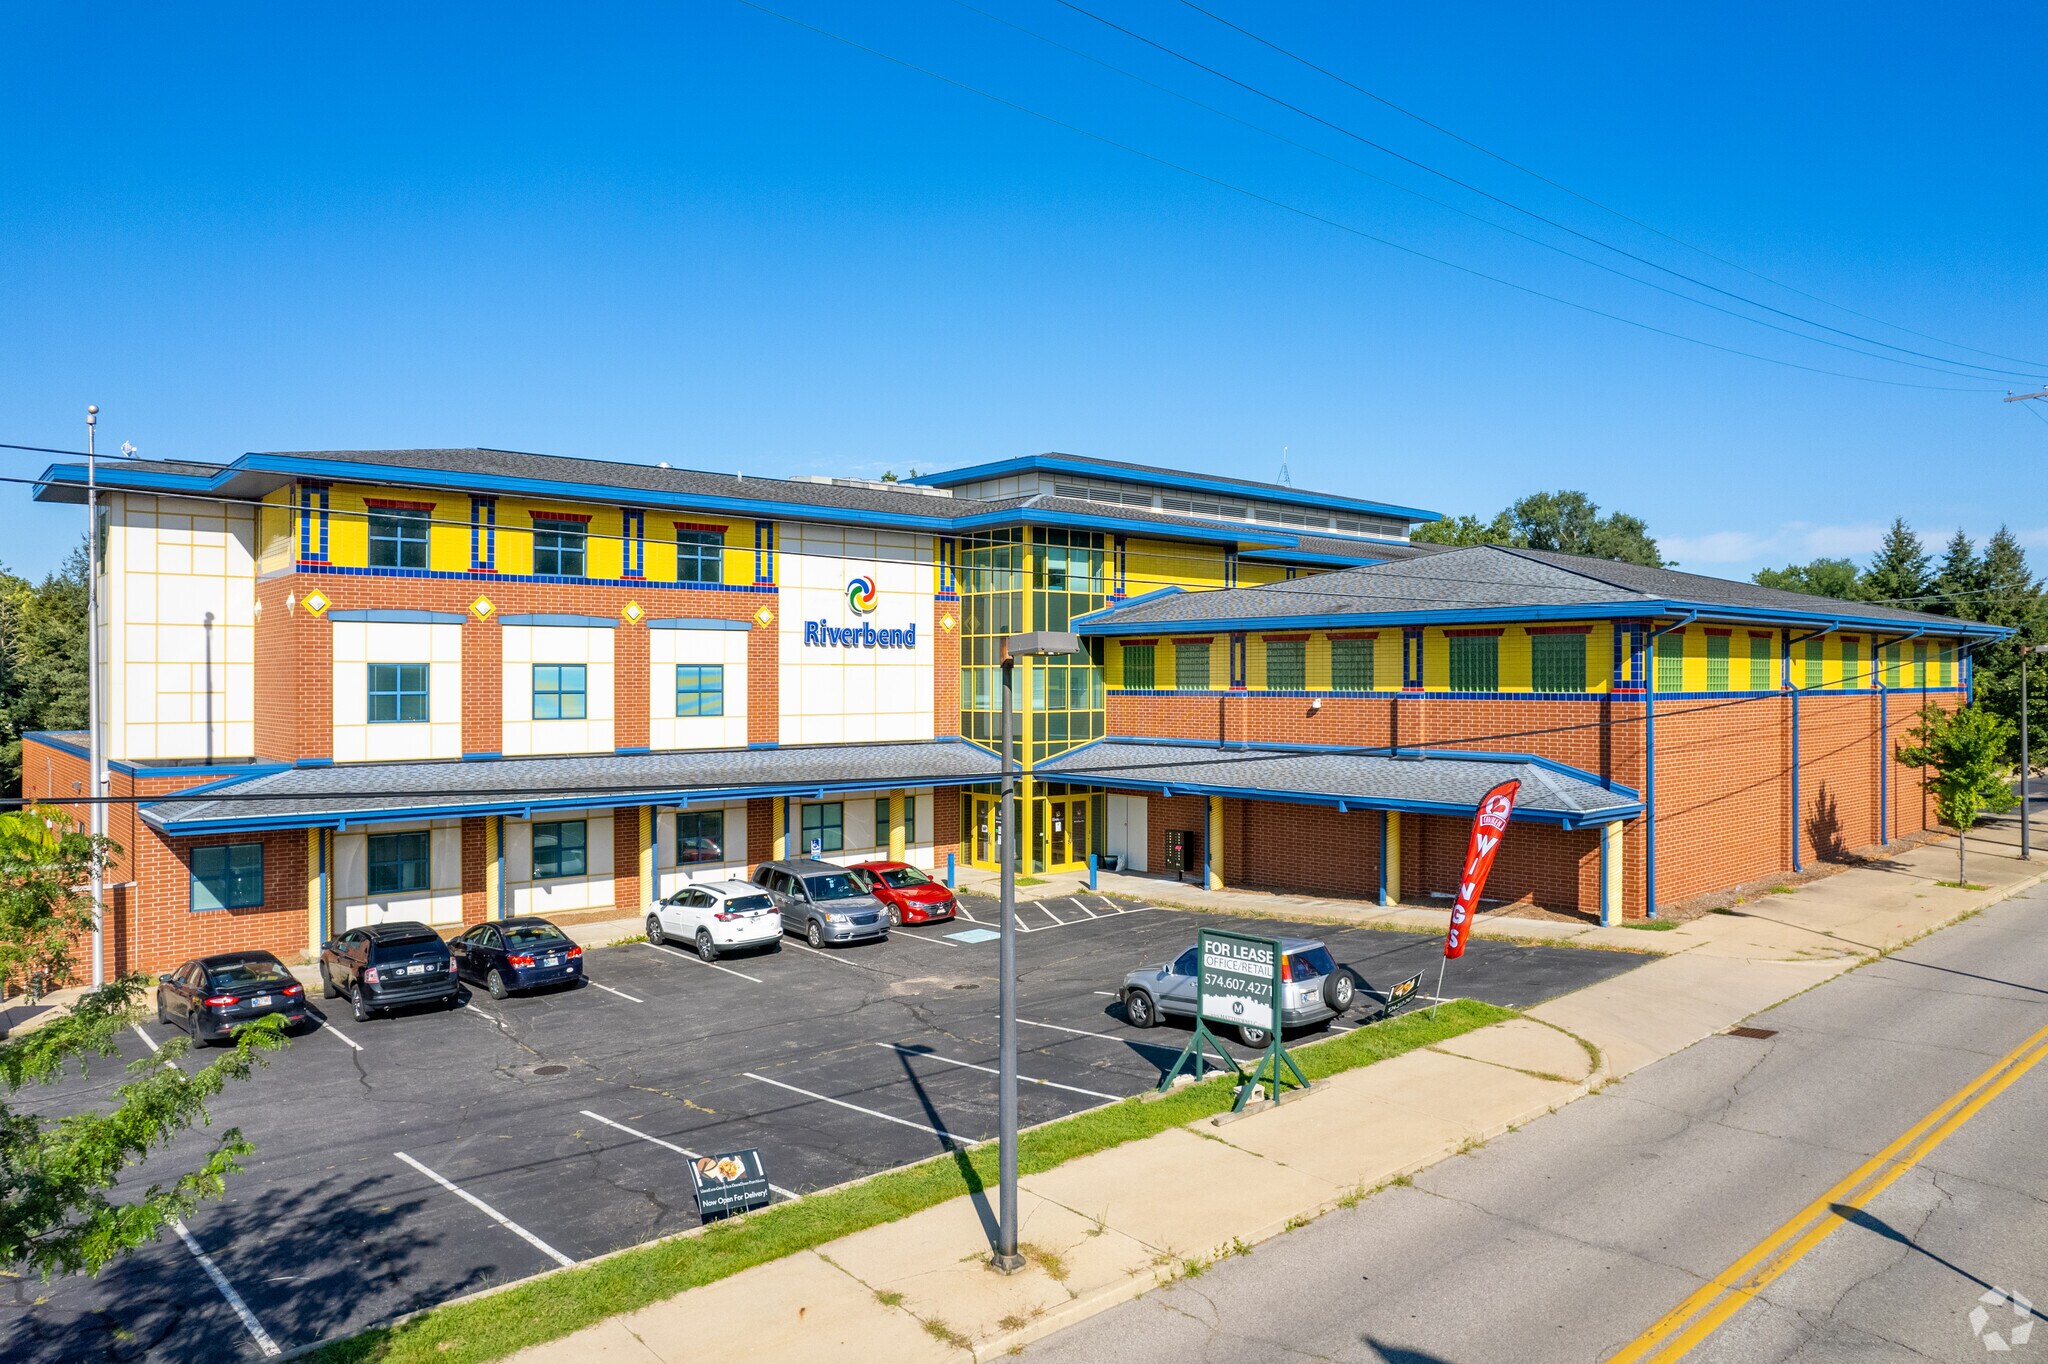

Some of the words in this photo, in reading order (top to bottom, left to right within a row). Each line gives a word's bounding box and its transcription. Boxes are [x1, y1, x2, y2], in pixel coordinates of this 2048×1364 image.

[804, 619, 916, 648] Riverbend
[1205, 940, 1230, 956] FOR
[1233, 945, 1274, 964] LEASE
[1206, 956, 1273, 976] OFFICE/RETAIL
[1204, 973, 1273, 997] 574.607.4271
[717, 1197, 733, 1206] Open
[734, 1194, 744, 1202] For
